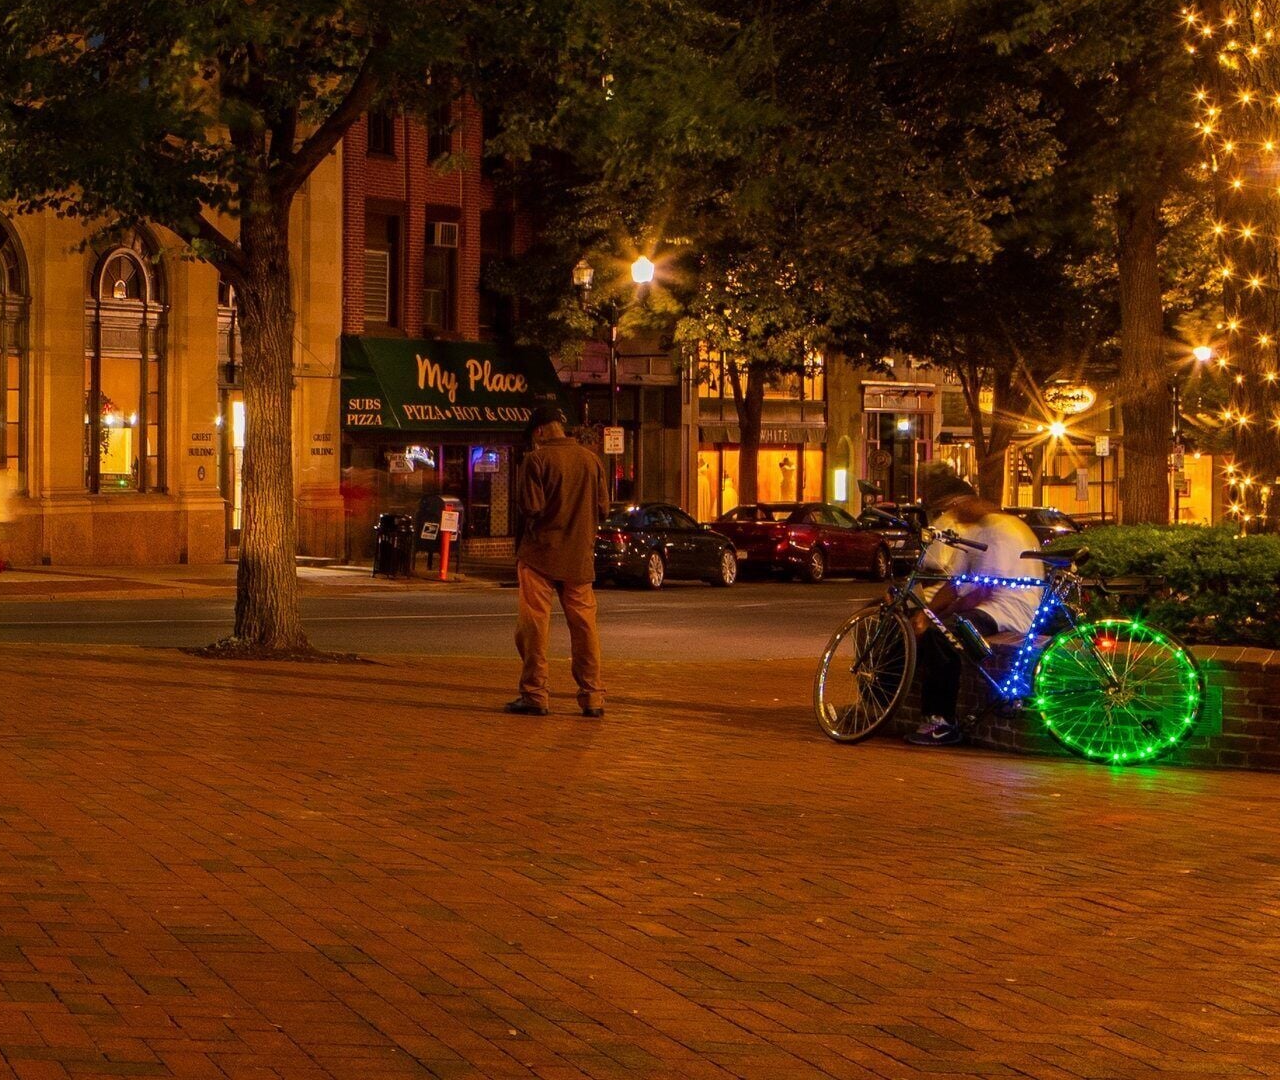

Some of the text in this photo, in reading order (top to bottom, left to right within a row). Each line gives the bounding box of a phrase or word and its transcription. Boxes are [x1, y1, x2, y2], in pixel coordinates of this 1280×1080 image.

[416, 353, 528, 403] My Place
[348, 398, 382, 410] SUBS
[346, 413, 383, 426] PIZZA
[402, 404, 446, 420] PIZZA
[451, 405, 482, 422] HOT
[484, 406, 497, 422] &
